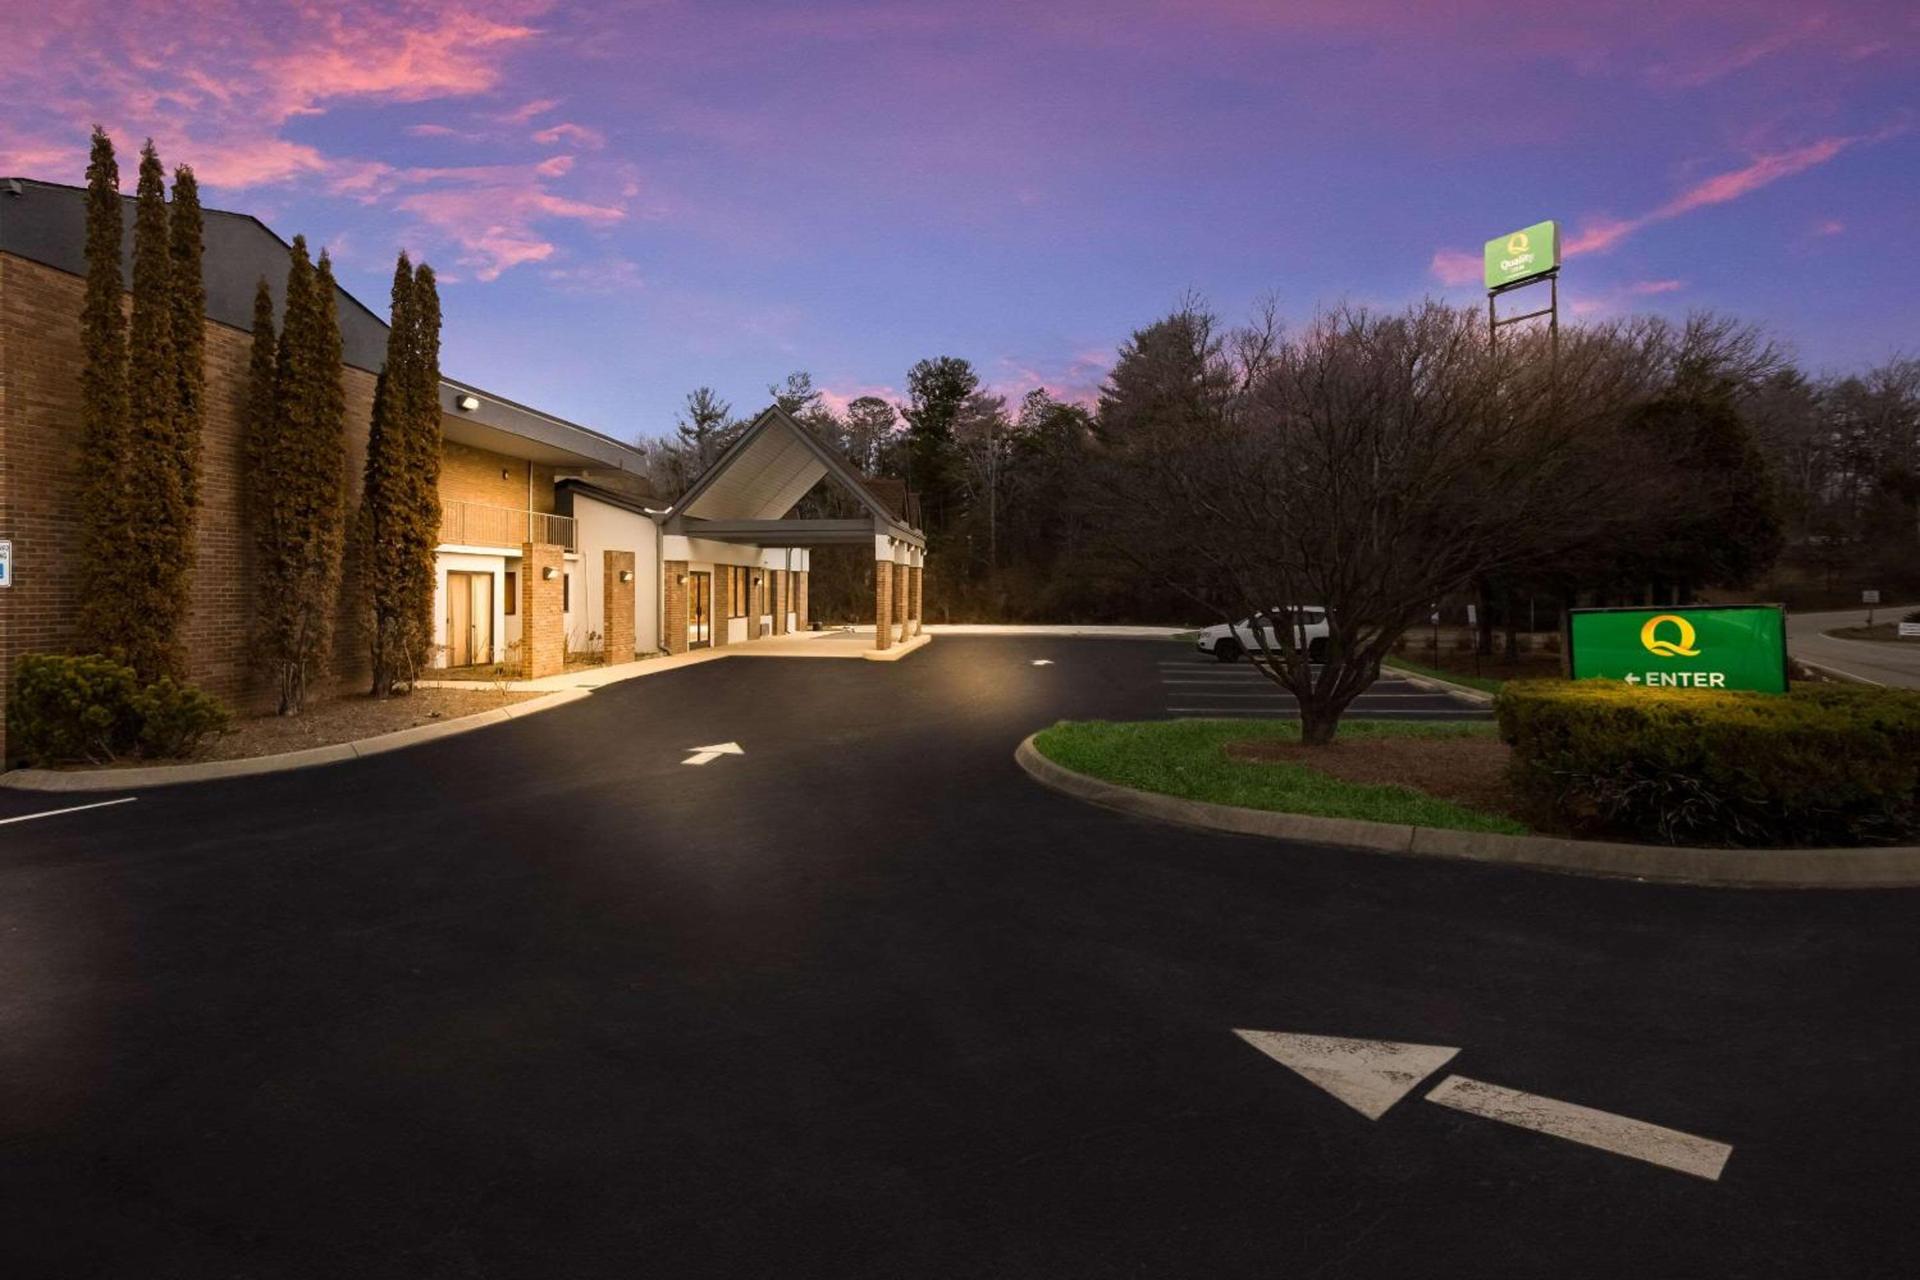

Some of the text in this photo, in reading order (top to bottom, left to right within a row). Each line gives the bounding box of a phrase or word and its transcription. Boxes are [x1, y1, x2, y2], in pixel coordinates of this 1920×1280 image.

[1507, 233, 1530, 255] Q
[1641, 614, 1701, 657] Q
[1645, 672, 1725, 687] ENTER
